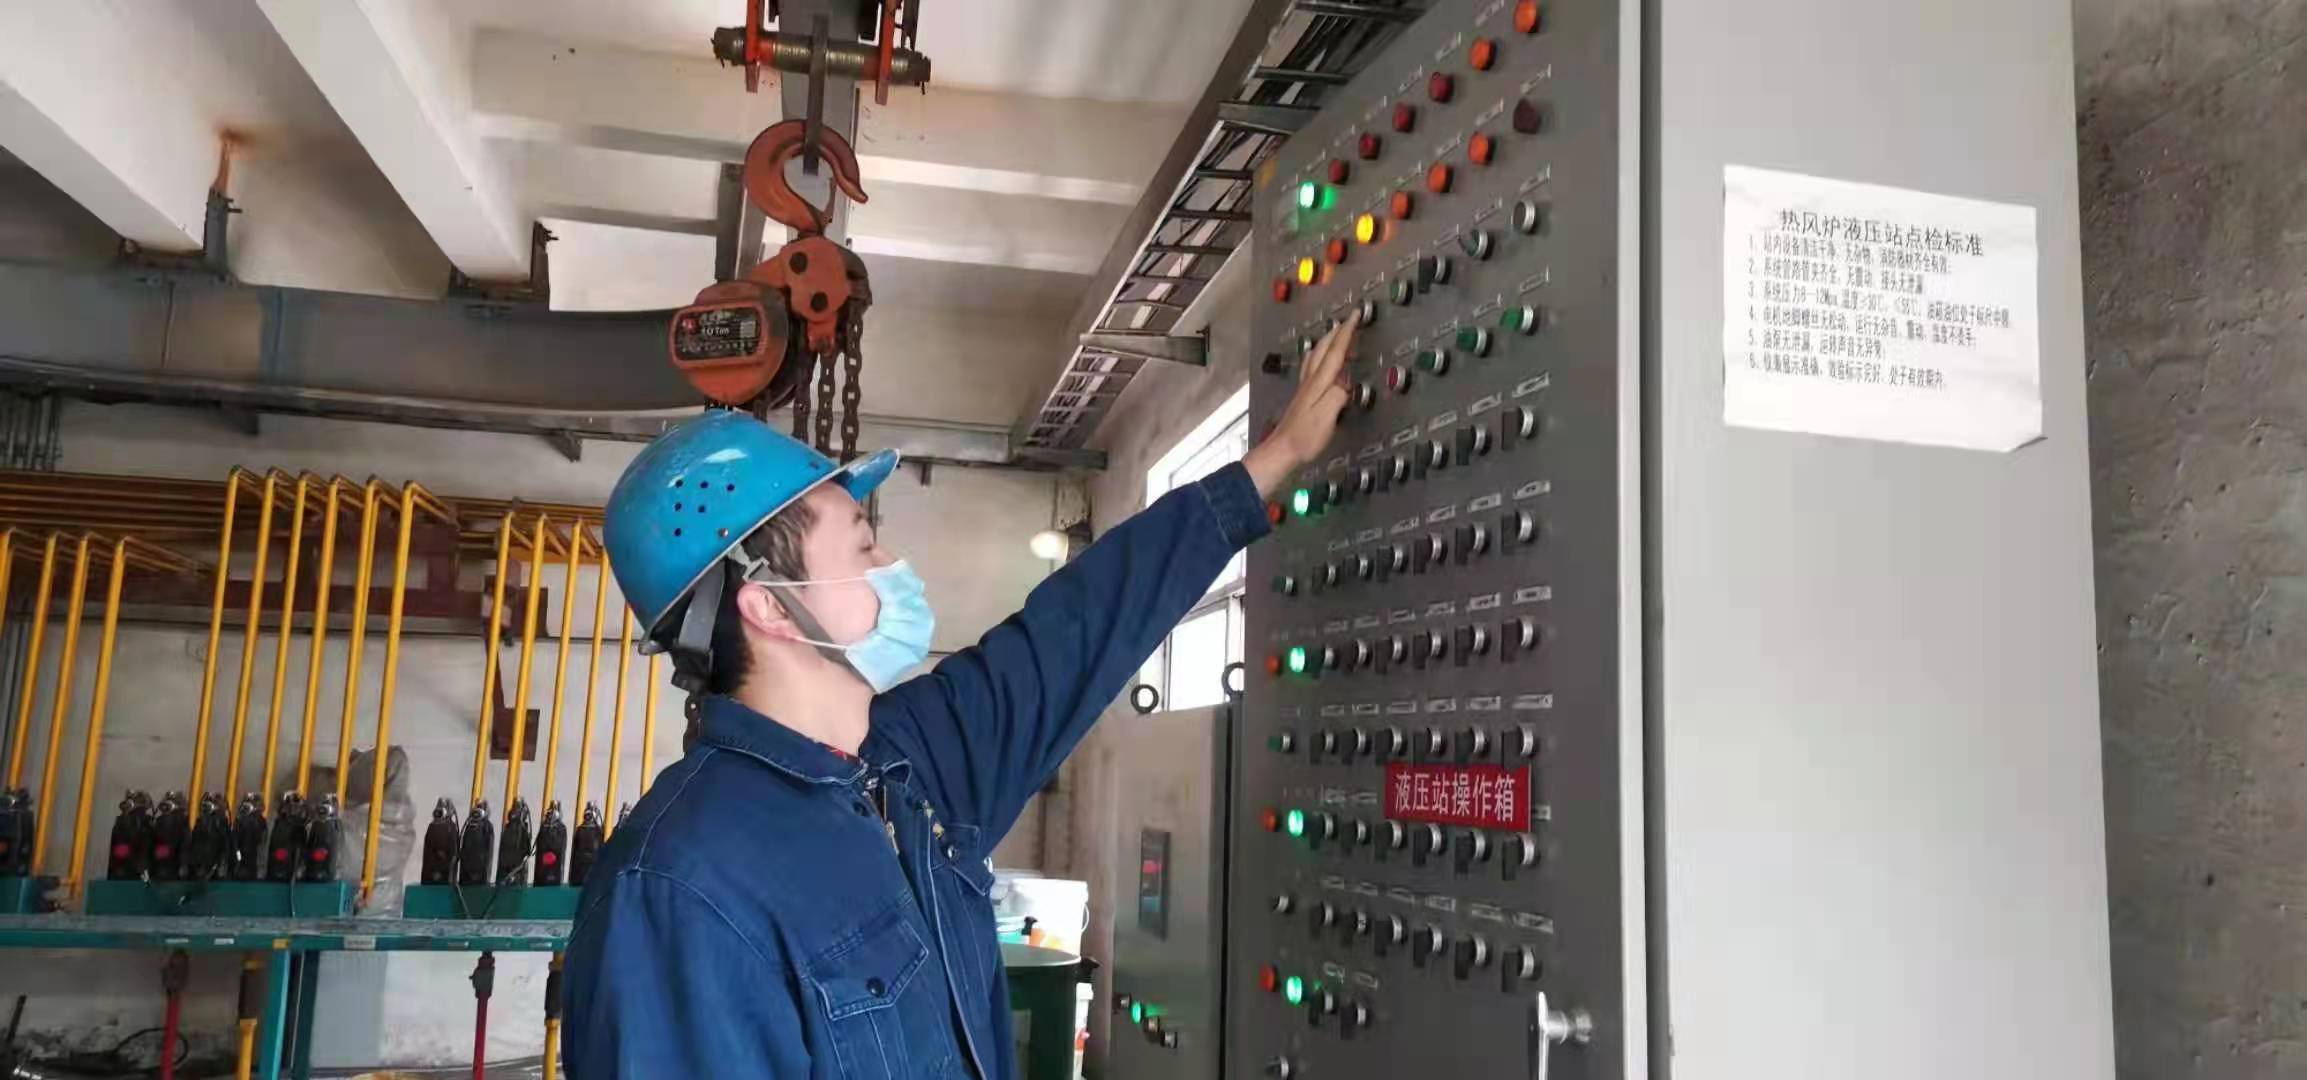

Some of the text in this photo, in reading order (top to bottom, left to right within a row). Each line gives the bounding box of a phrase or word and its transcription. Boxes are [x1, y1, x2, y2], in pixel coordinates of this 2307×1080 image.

[1780, 208, 1985, 257] 热风炉液压站点检标准
[1394, 768, 1516, 822] 液压站操作箱
